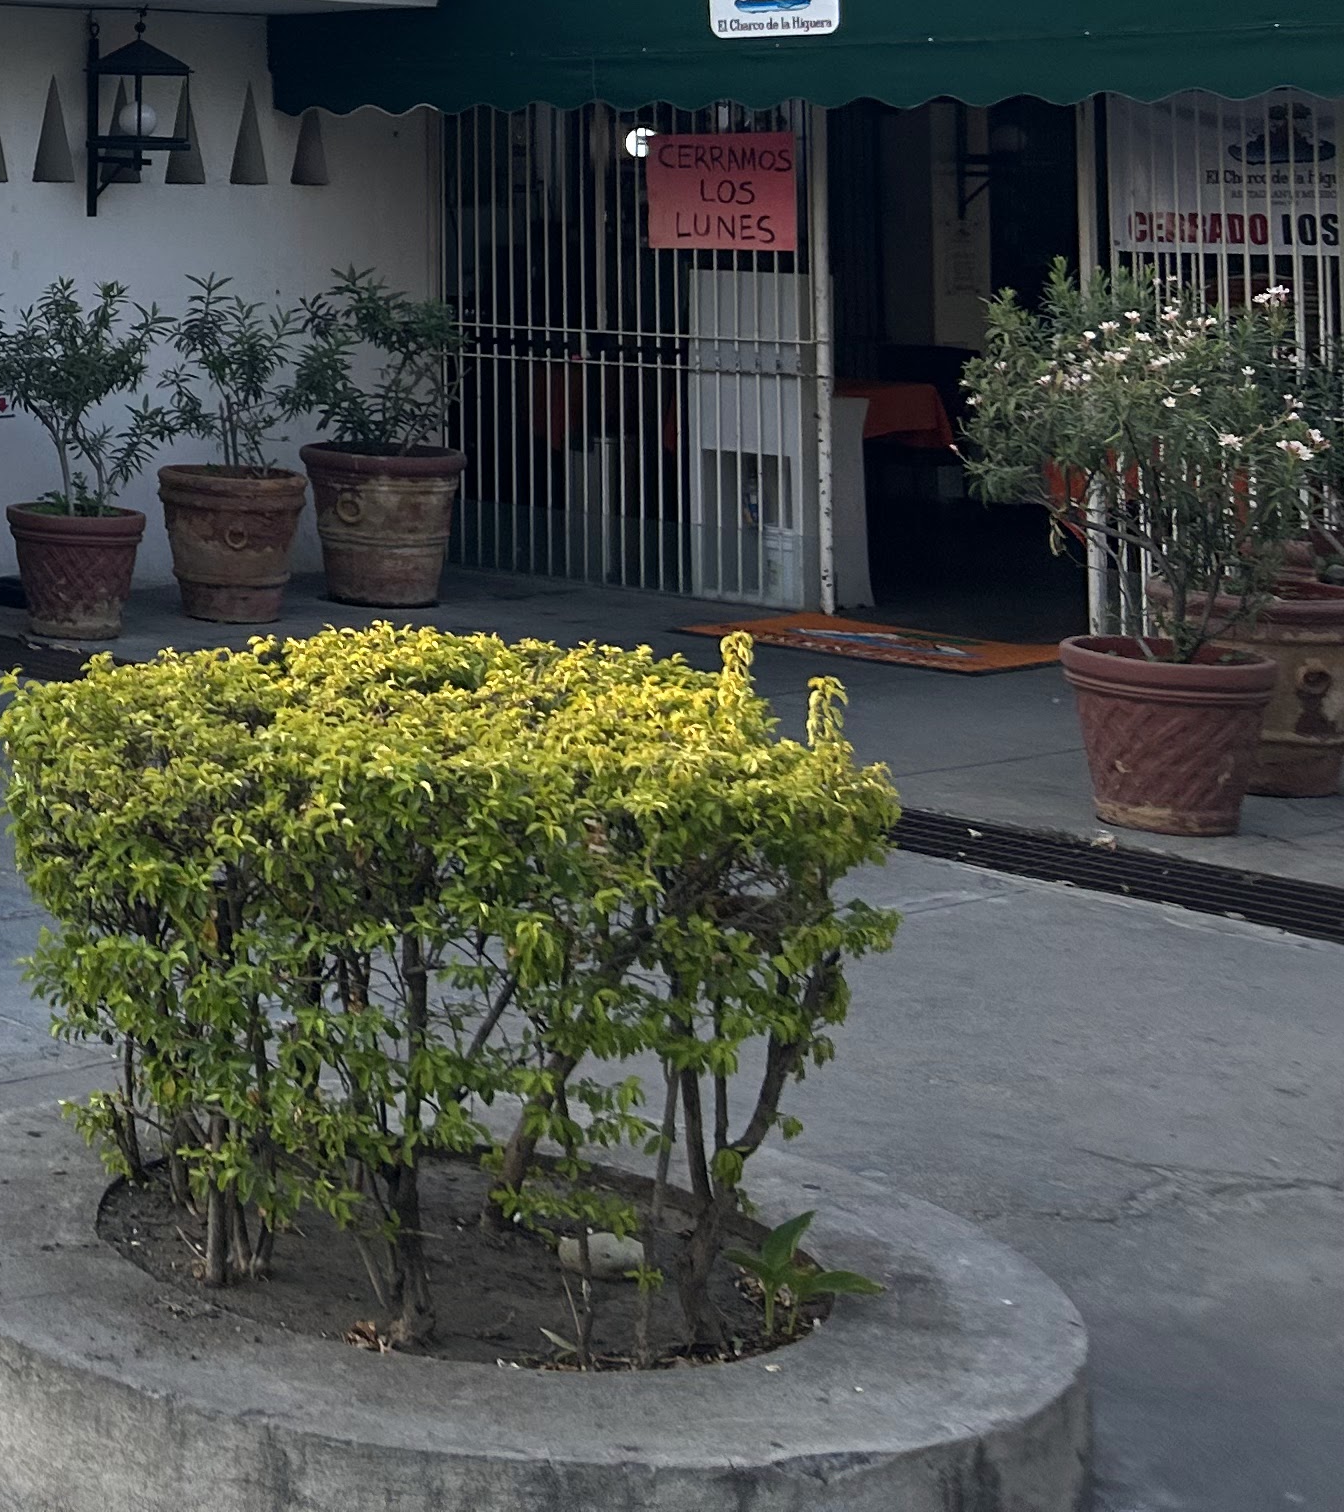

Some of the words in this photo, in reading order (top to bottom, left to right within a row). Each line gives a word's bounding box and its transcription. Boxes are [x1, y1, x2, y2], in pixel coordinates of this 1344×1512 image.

[718, 20, 727, 32] El
[730, 19, 764, 32] Charco
[766, 18, 779, 30] de
[781, 17, 790, 29] la
[793, 16, 832, 32] Higuera
[658, 144, 792, 172] CERRAMOS
[700, 179, 755, 205] LOS
[676, 212, 775, 243] LUNES
